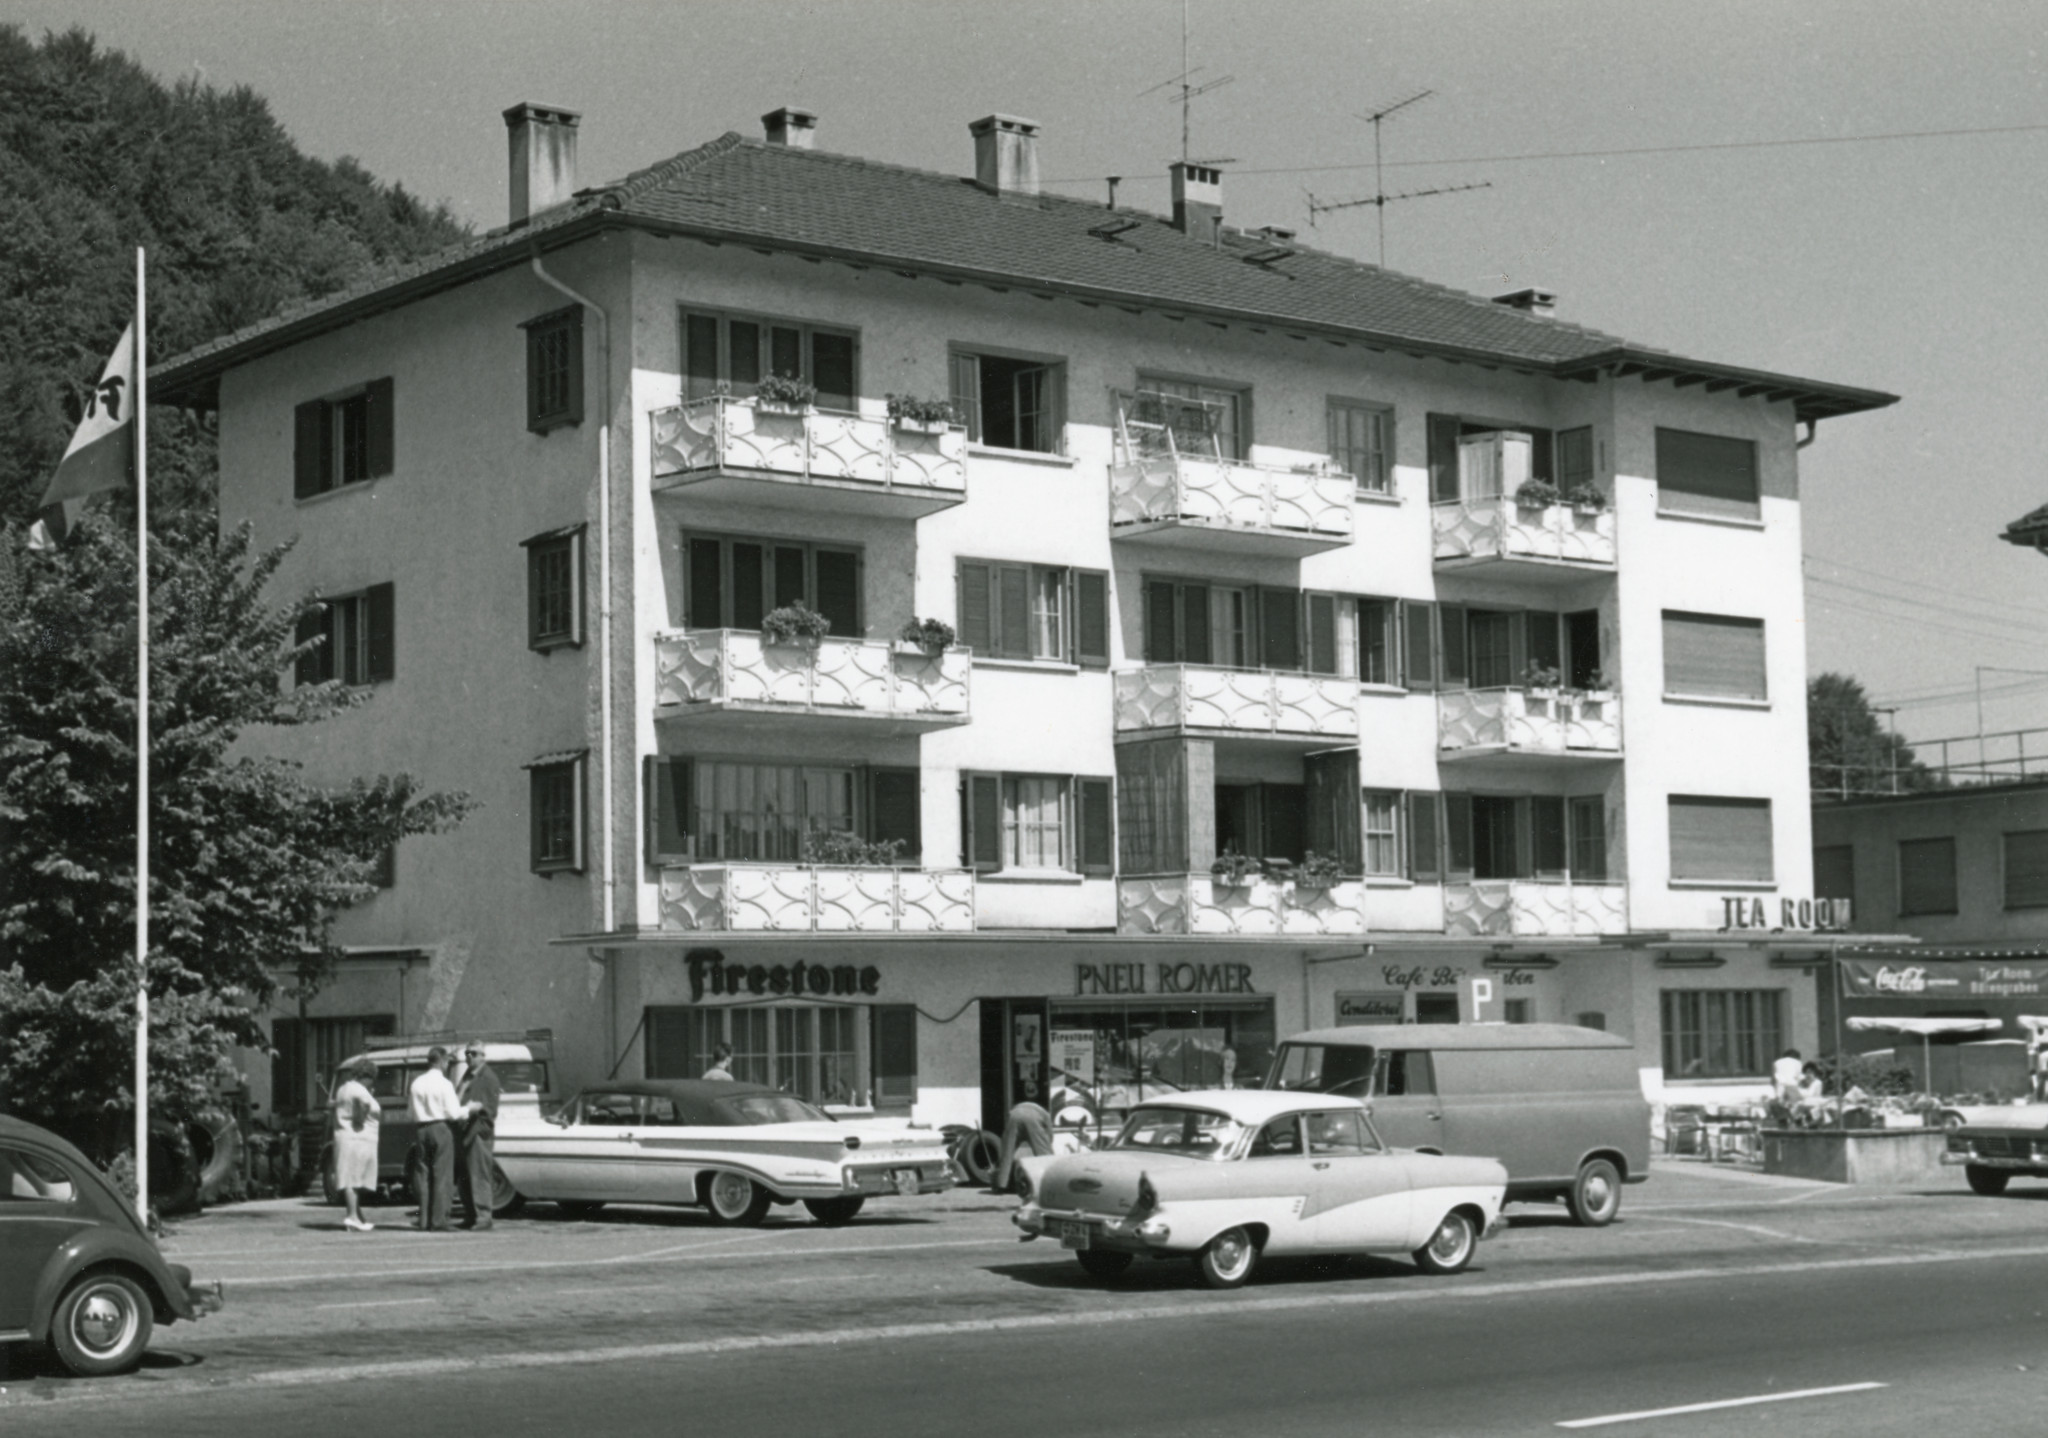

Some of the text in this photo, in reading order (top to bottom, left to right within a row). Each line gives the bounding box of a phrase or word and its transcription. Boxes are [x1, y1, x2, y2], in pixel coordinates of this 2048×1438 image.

[1720, 897, 1851, 930] TEA ROOM
[684, 947, 881, 1003] Firestone
[1075, 962, 1256, 995] PNEU ROMER
[1381, 965, 1428, 990] Café
[1471, 978, 1493, 1021] P
[1050, 1031, 1094, 1044] Firestone
